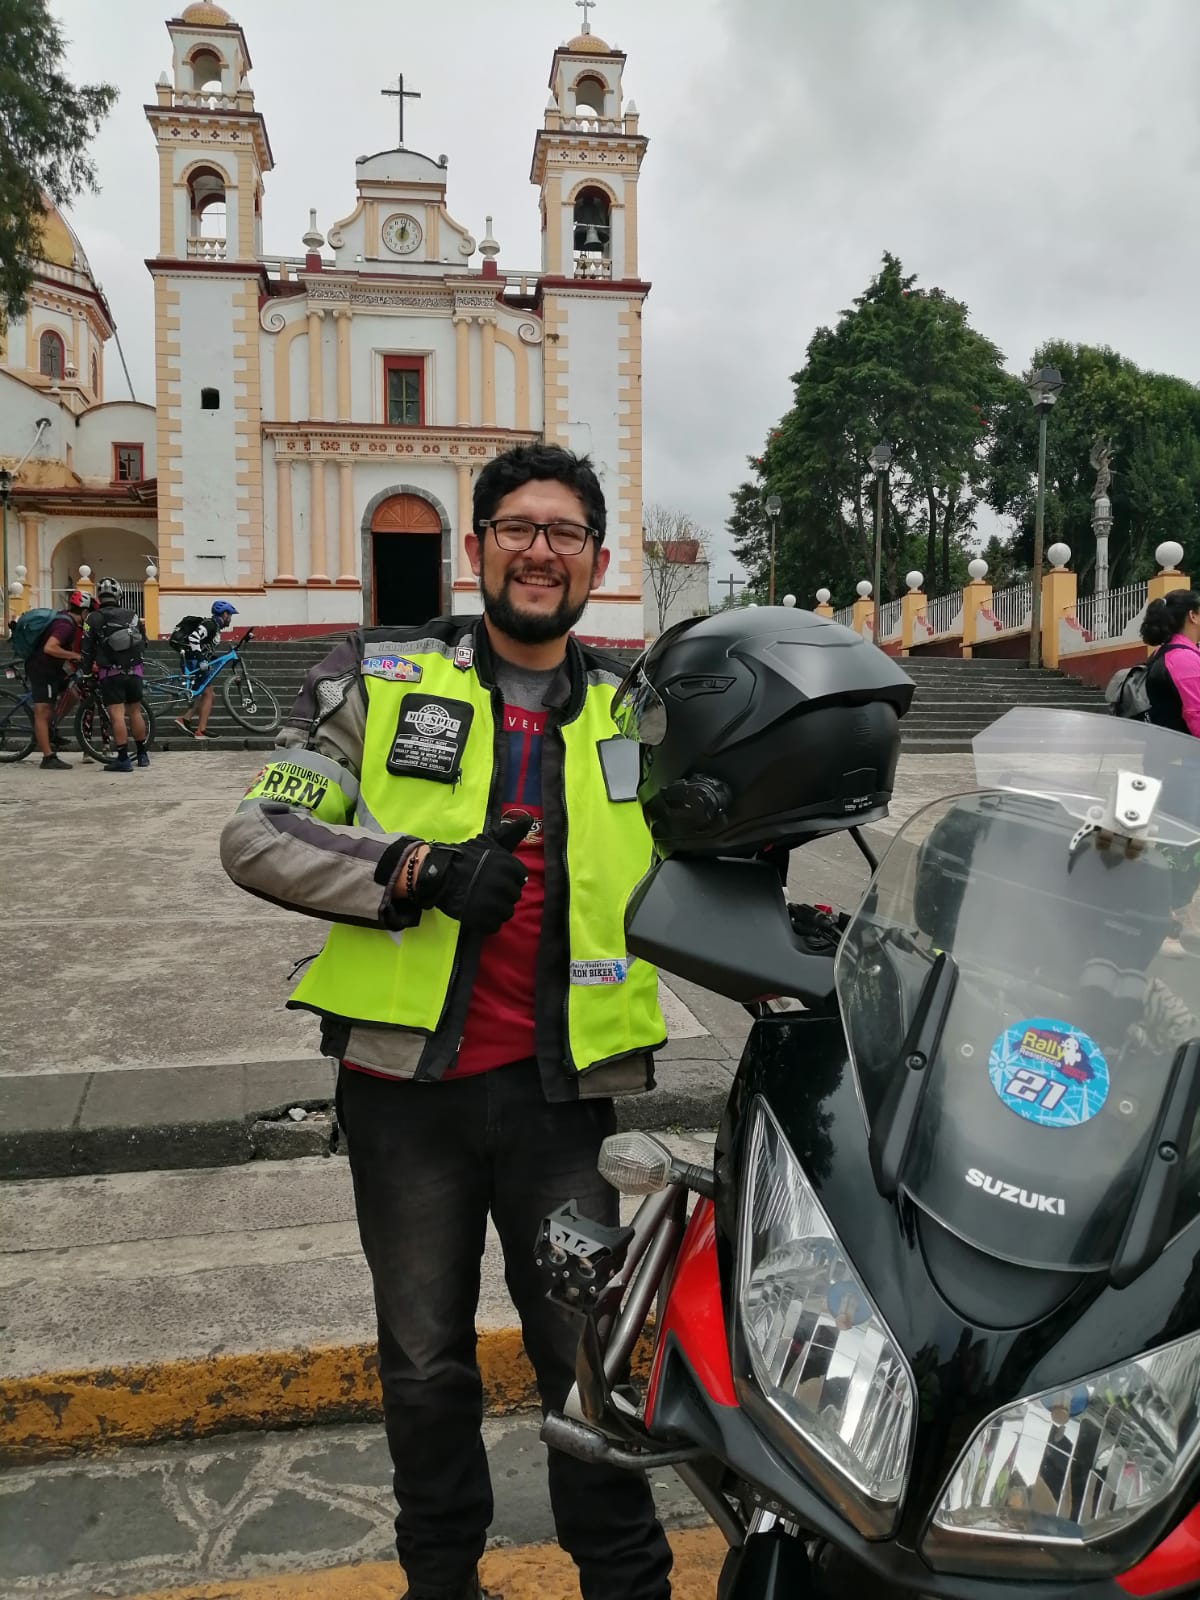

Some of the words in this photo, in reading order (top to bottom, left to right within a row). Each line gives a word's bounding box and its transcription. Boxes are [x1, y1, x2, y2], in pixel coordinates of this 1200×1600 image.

[368, 658, 414, 675] RRM
[263, 770, 327, 810] RRM
[1022, 1031, 1066, 1060] Rally
[1004, 1068, 1068, 1111] 21
[965, 1167, 1066, 1216] SUZUKI
